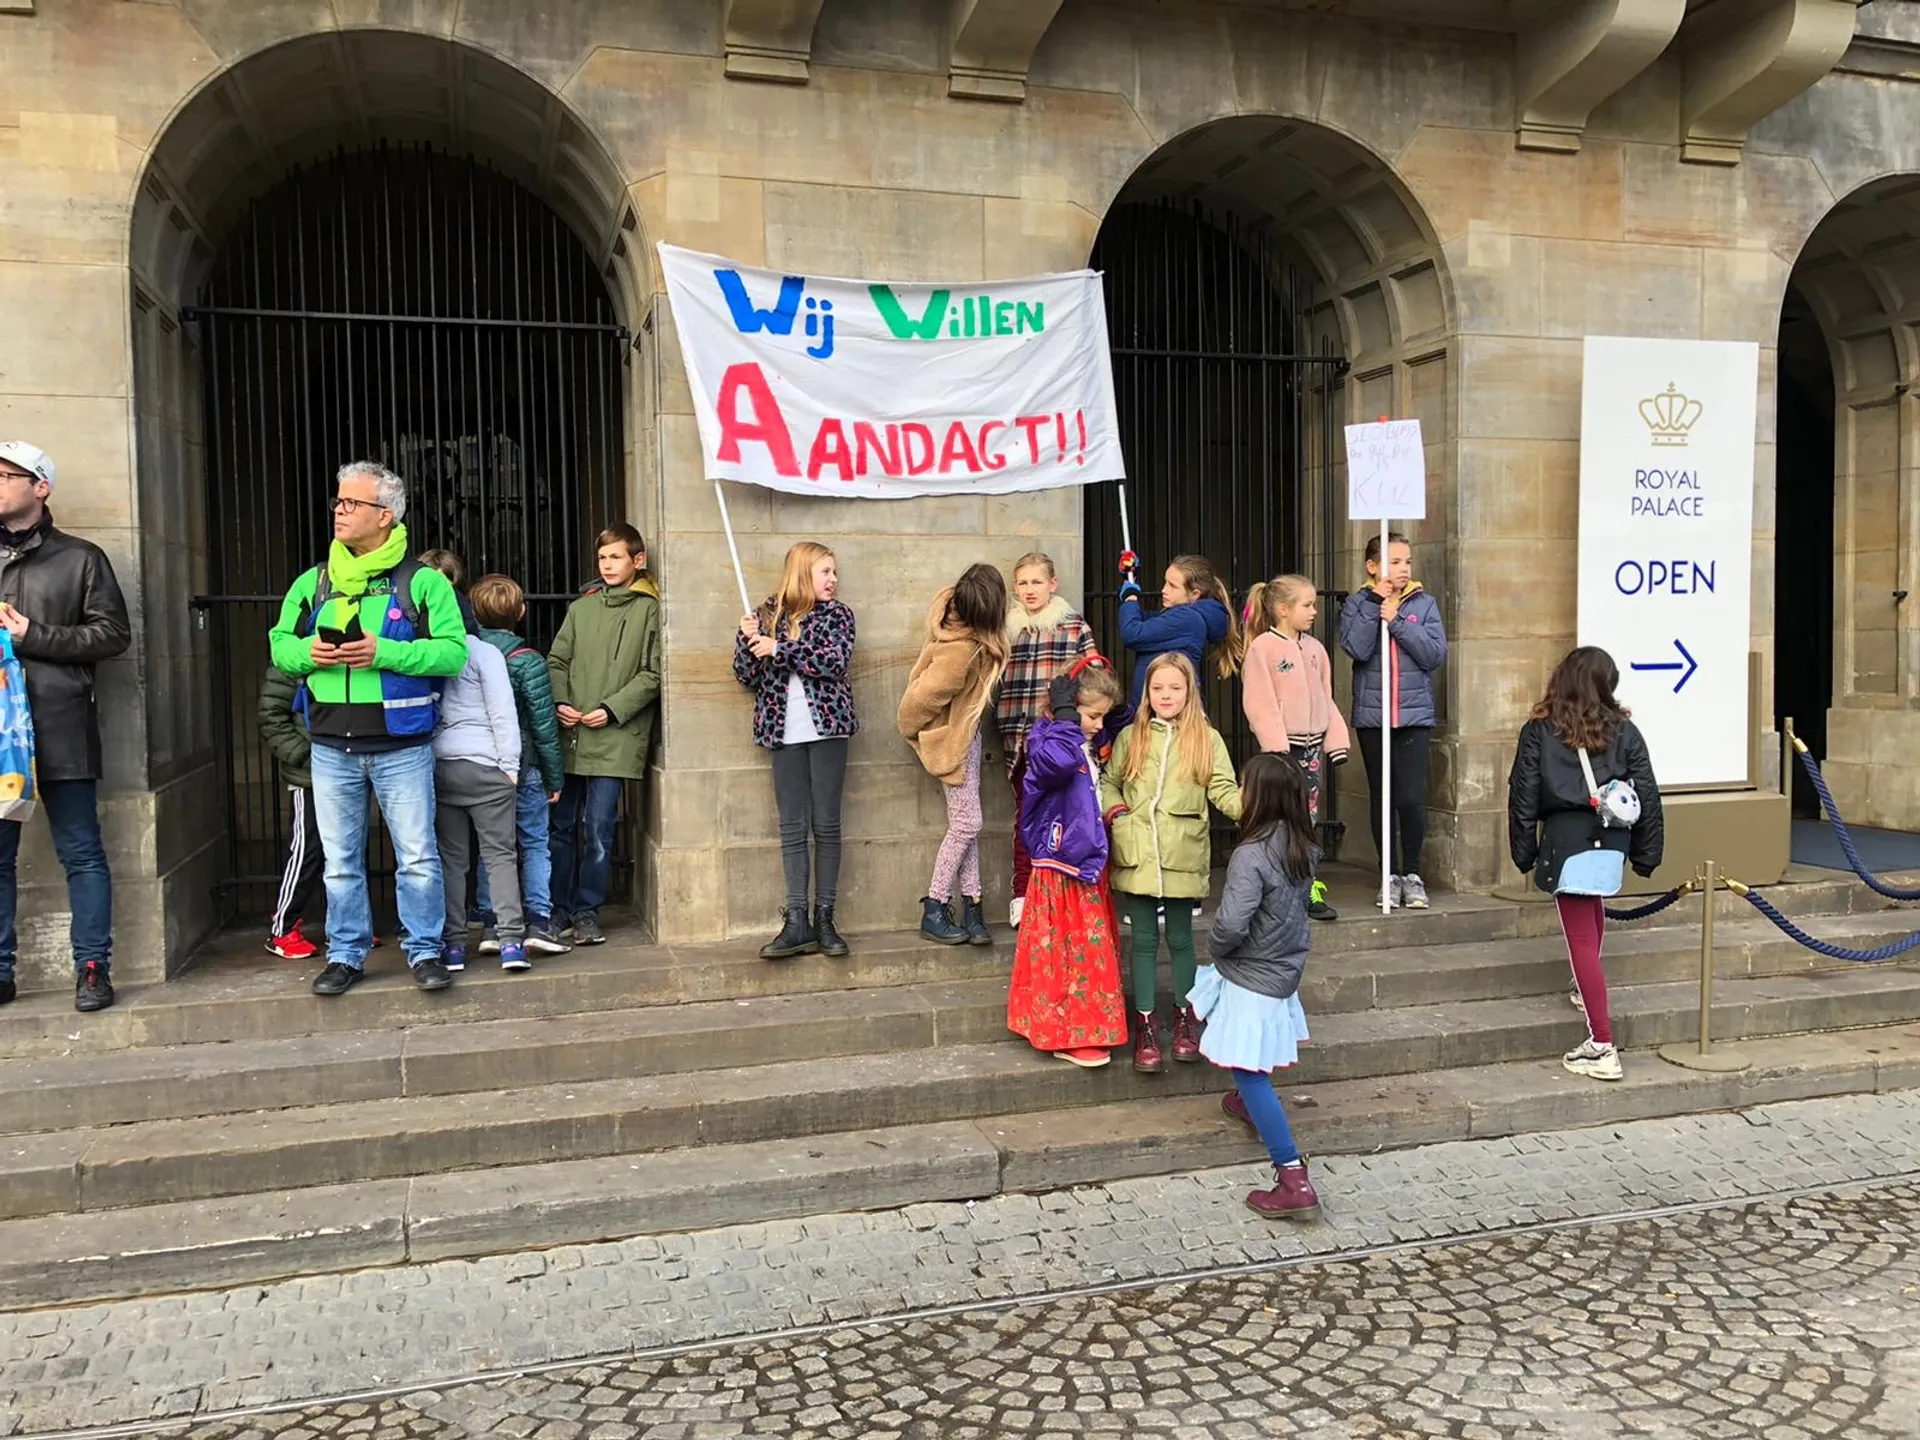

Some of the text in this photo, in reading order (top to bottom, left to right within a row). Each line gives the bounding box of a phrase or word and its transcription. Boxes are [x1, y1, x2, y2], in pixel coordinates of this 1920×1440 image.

[714, 269, 834, 359] Wij
[1635, 469, 1700, 490] ROYAL
[1631, 496, 1704, 517] PALACE
[1615, 560, 1716, 595] OPEN
